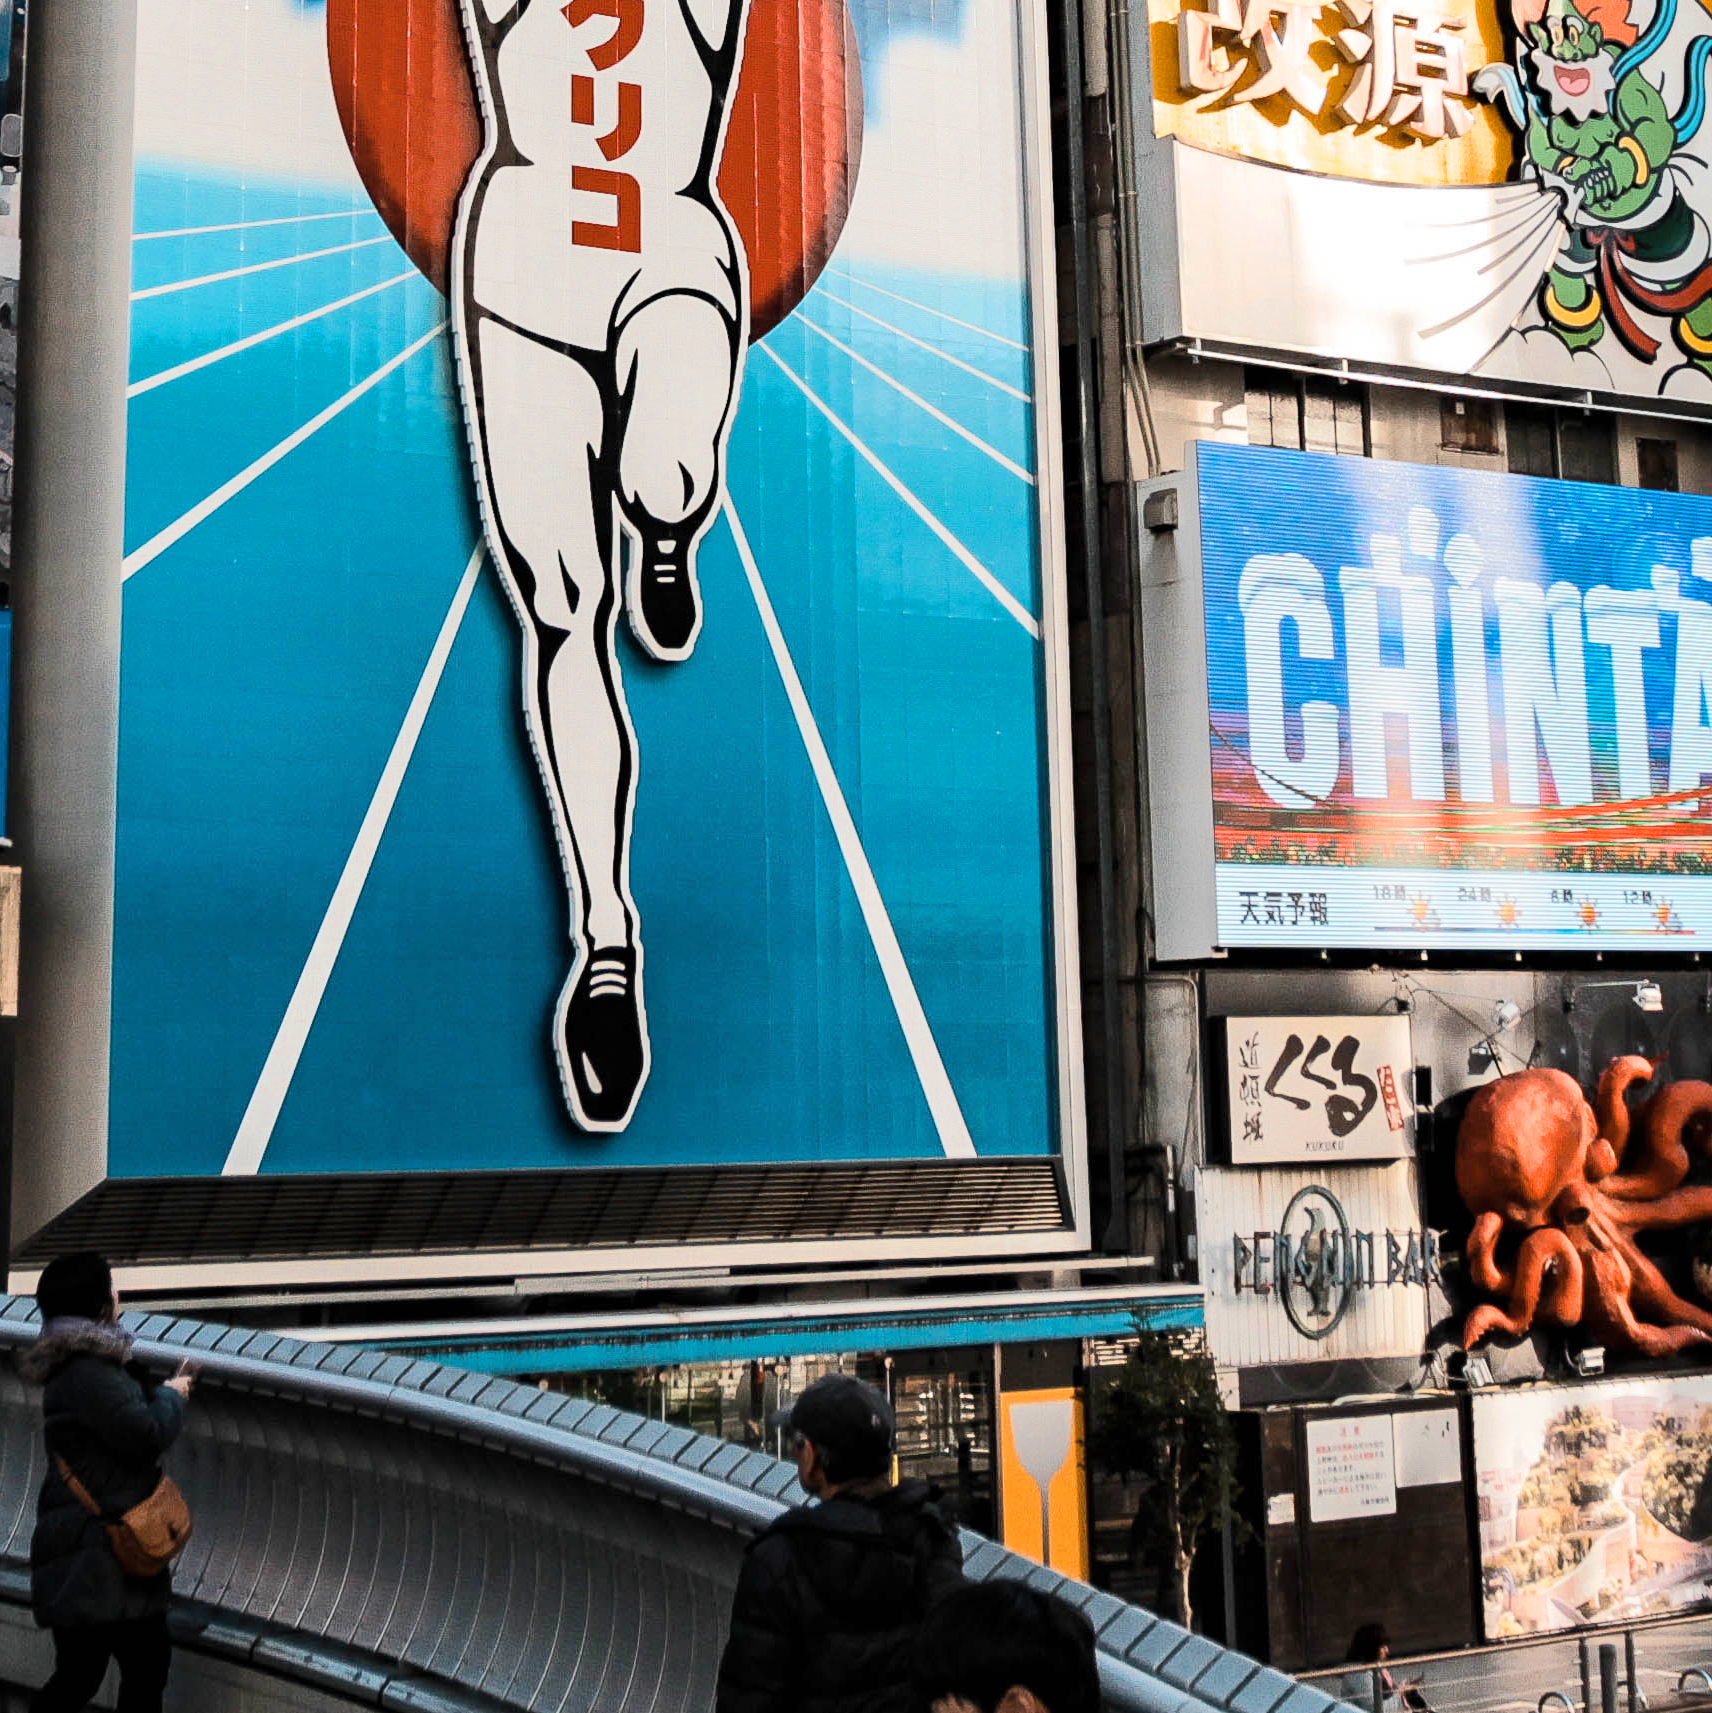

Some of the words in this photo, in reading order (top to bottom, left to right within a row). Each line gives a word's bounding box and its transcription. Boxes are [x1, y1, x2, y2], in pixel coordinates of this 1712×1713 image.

[1238, 890, 1329, 928] 天気予報
[1264, 1033, 1378, 1138] くくる
[1304, 1139, 1346, 1153] KUKURU
